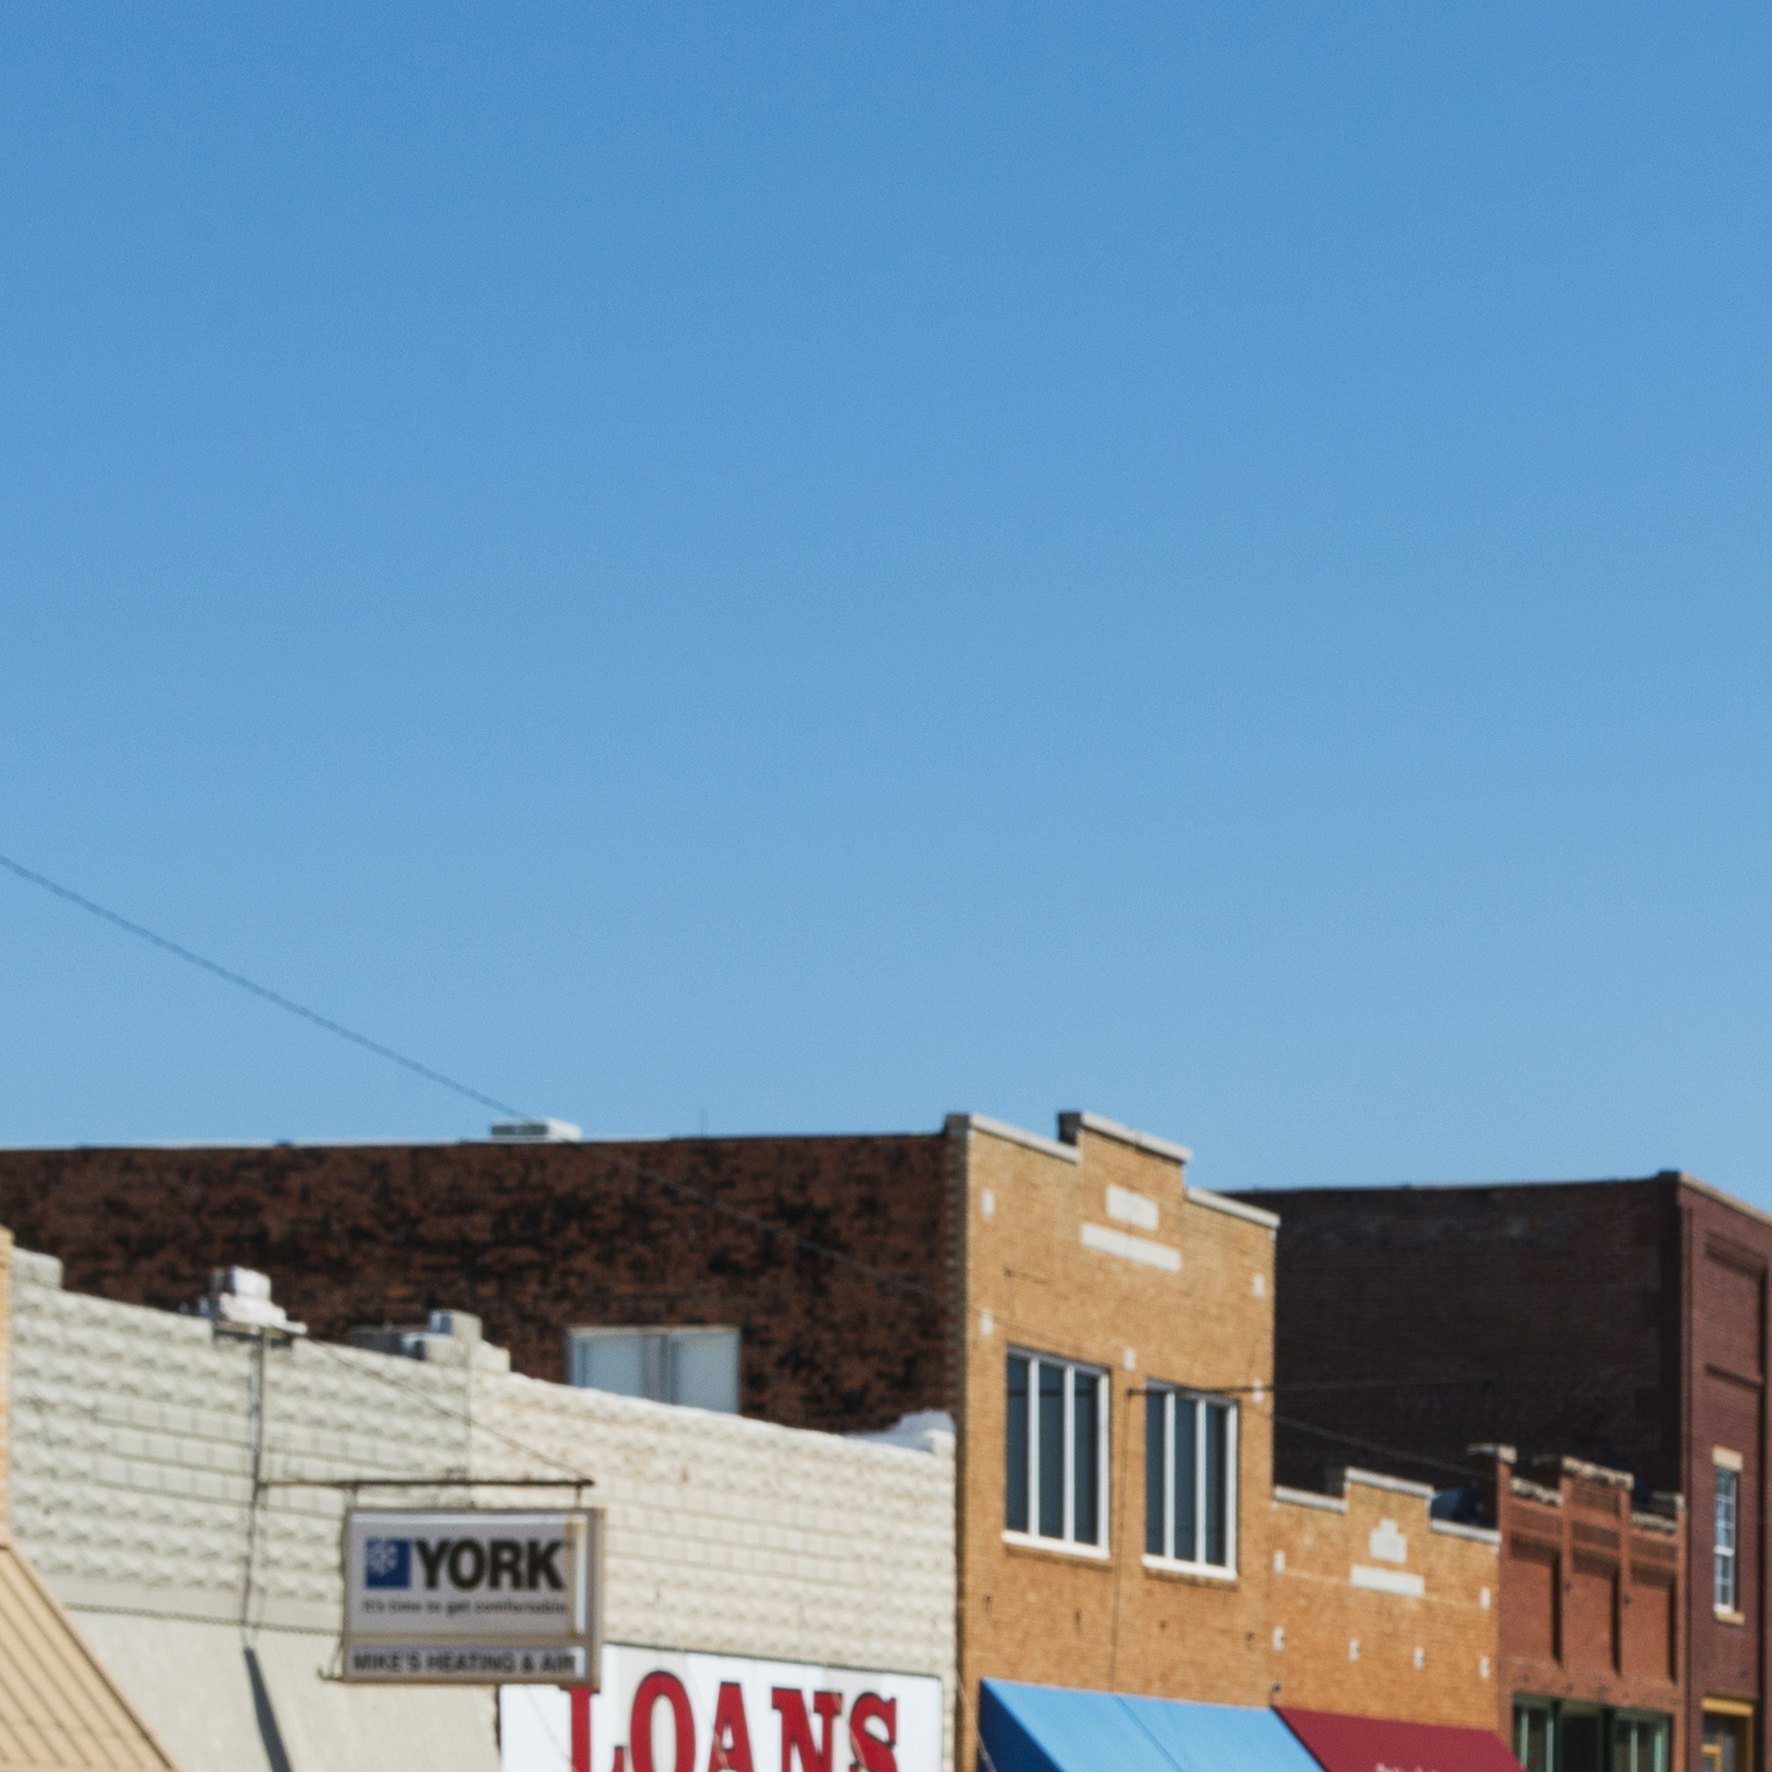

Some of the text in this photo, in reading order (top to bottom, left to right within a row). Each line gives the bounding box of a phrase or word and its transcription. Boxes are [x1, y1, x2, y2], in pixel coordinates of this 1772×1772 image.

[416, 1538, 566, 1590] YORK
[353, 1653, 423, 1672] MIKE'S
[426, 1653, 516, 1673] HEATING
[540, 1655, 575, 1672] AIR
